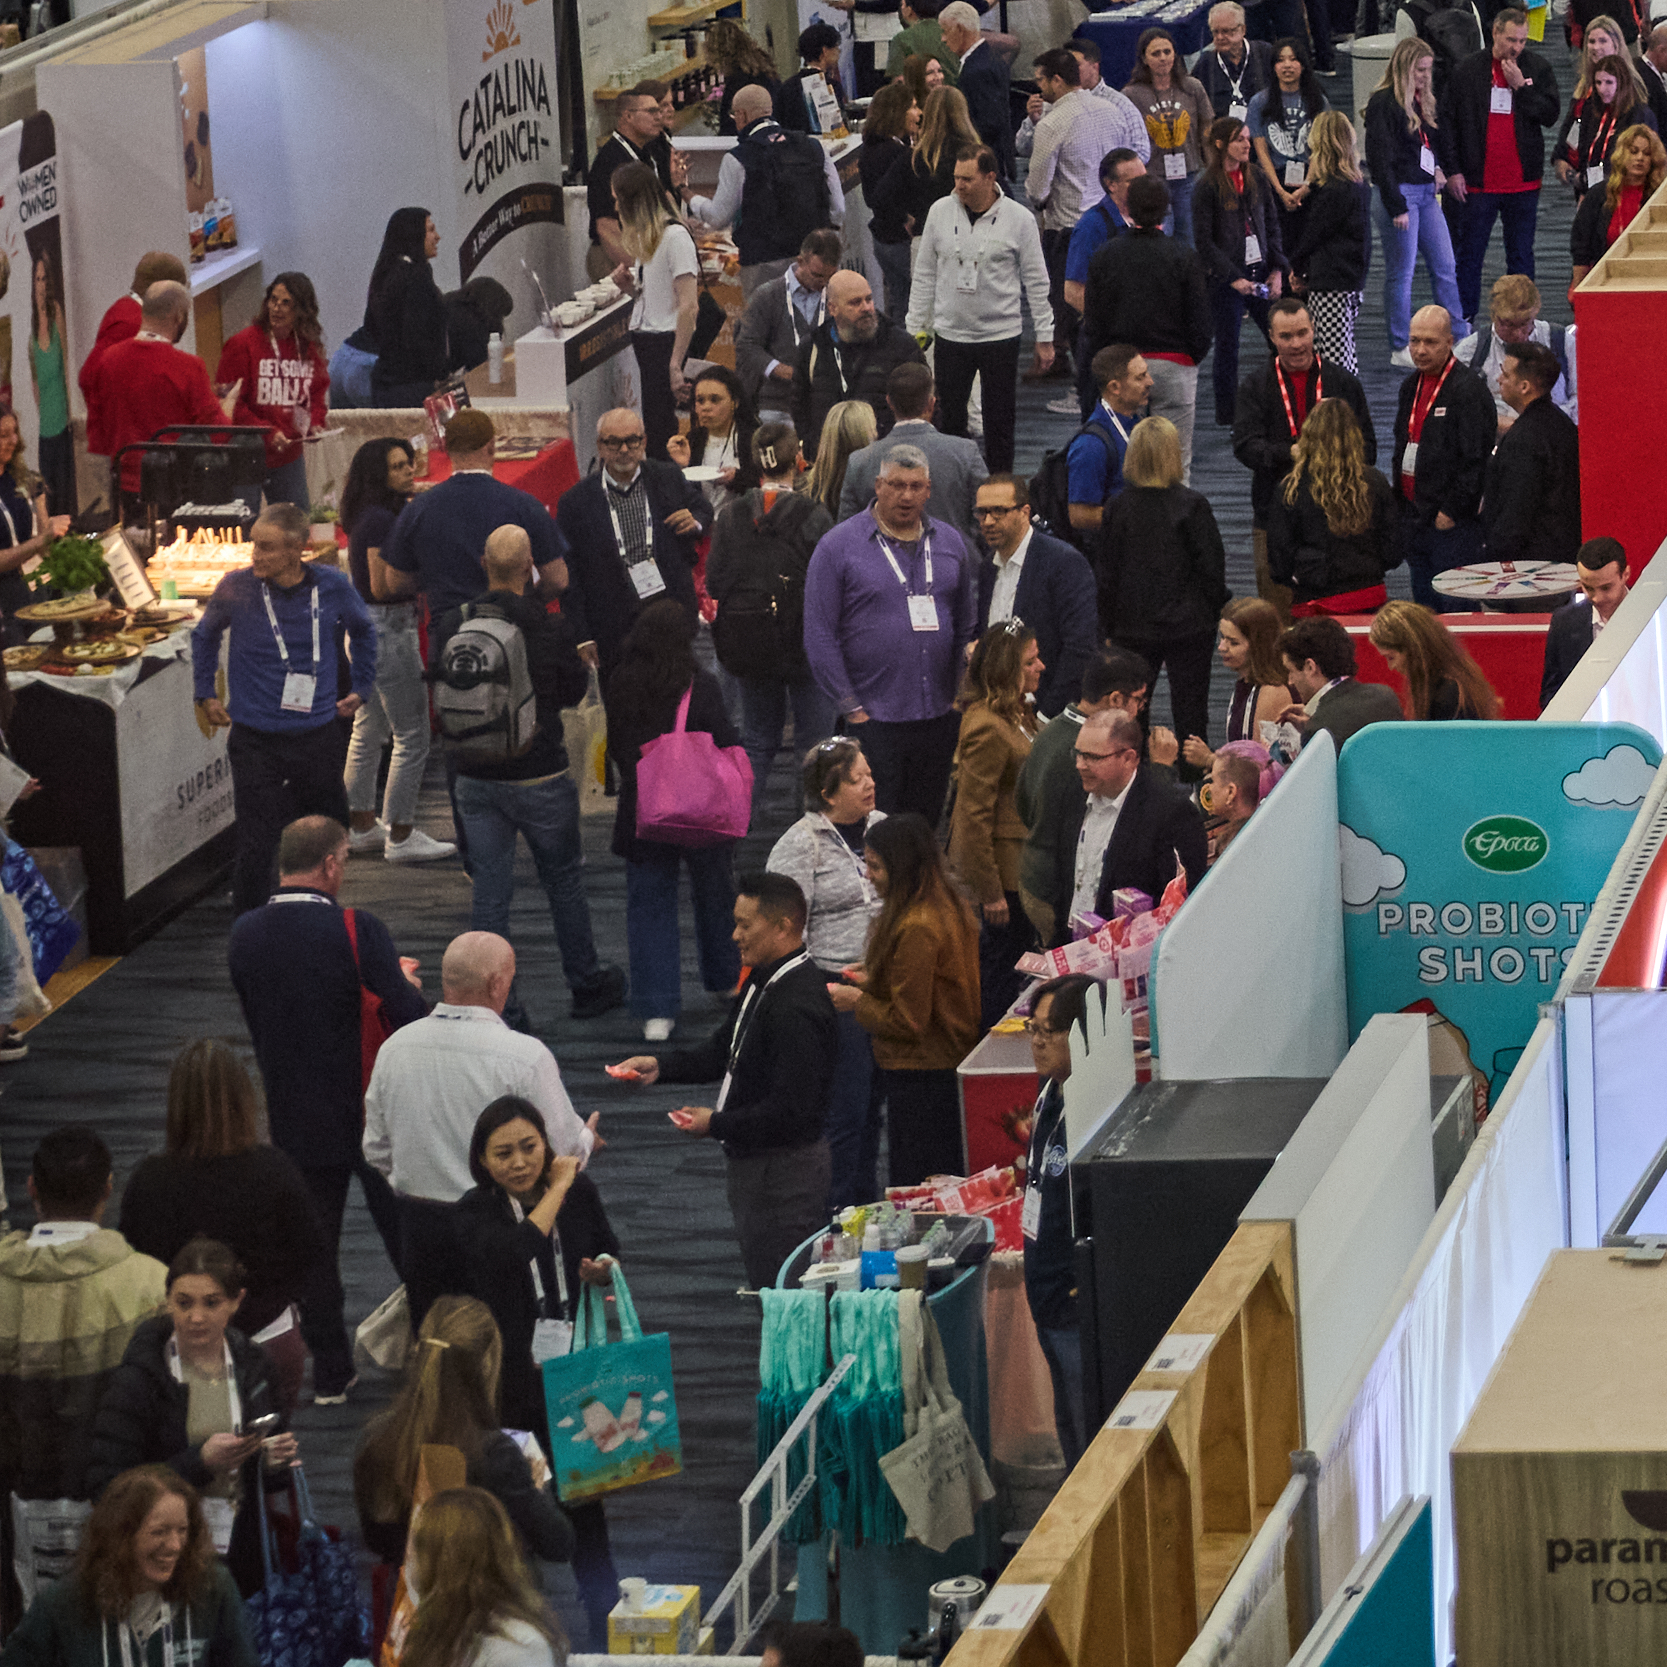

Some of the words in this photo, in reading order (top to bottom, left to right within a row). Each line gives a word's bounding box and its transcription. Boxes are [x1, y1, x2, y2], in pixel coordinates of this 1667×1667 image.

[458, 58, 551, 162] CATALINA
[474, 119, 541, 196] CRUNCH
[19, 186, 58, 224] OWNED
[258, 357, 279, 378] GET
[280, 358, 315, 378] SOME
[256, 377, 313, 407] BALLS
[1467, 829, 1542, 860] Epoca
